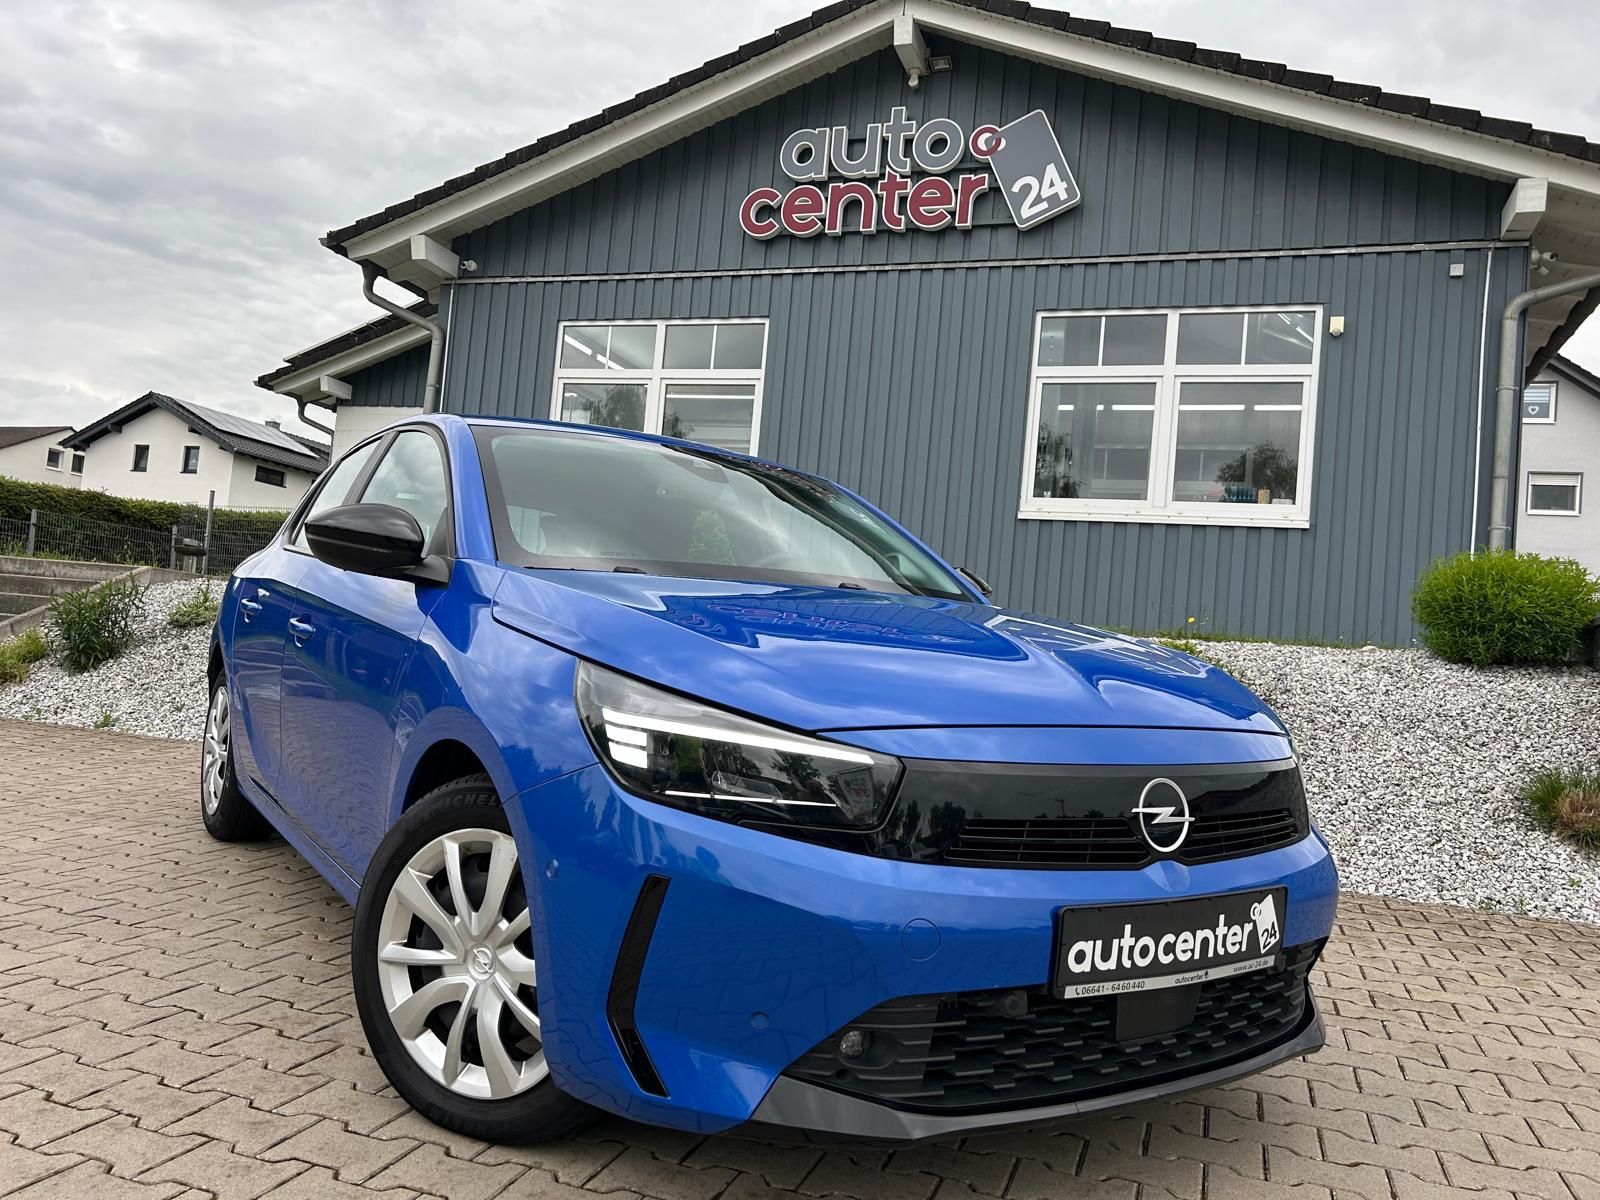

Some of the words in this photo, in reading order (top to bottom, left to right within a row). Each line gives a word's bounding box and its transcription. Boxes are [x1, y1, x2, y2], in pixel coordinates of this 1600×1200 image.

[780, 106, 966, 182] auto
[739, 165, 989, 240] center
[1010, 162, 1068, 219] 24
[433, 792, 502, 808] MICHEL
[1067, 913, 1253, 973] autocenter
[1261, 920, 1278, 950] 24
[1081, 985, 1105, 995] 06641
[1174, 972, 1204, 984] autocenter
